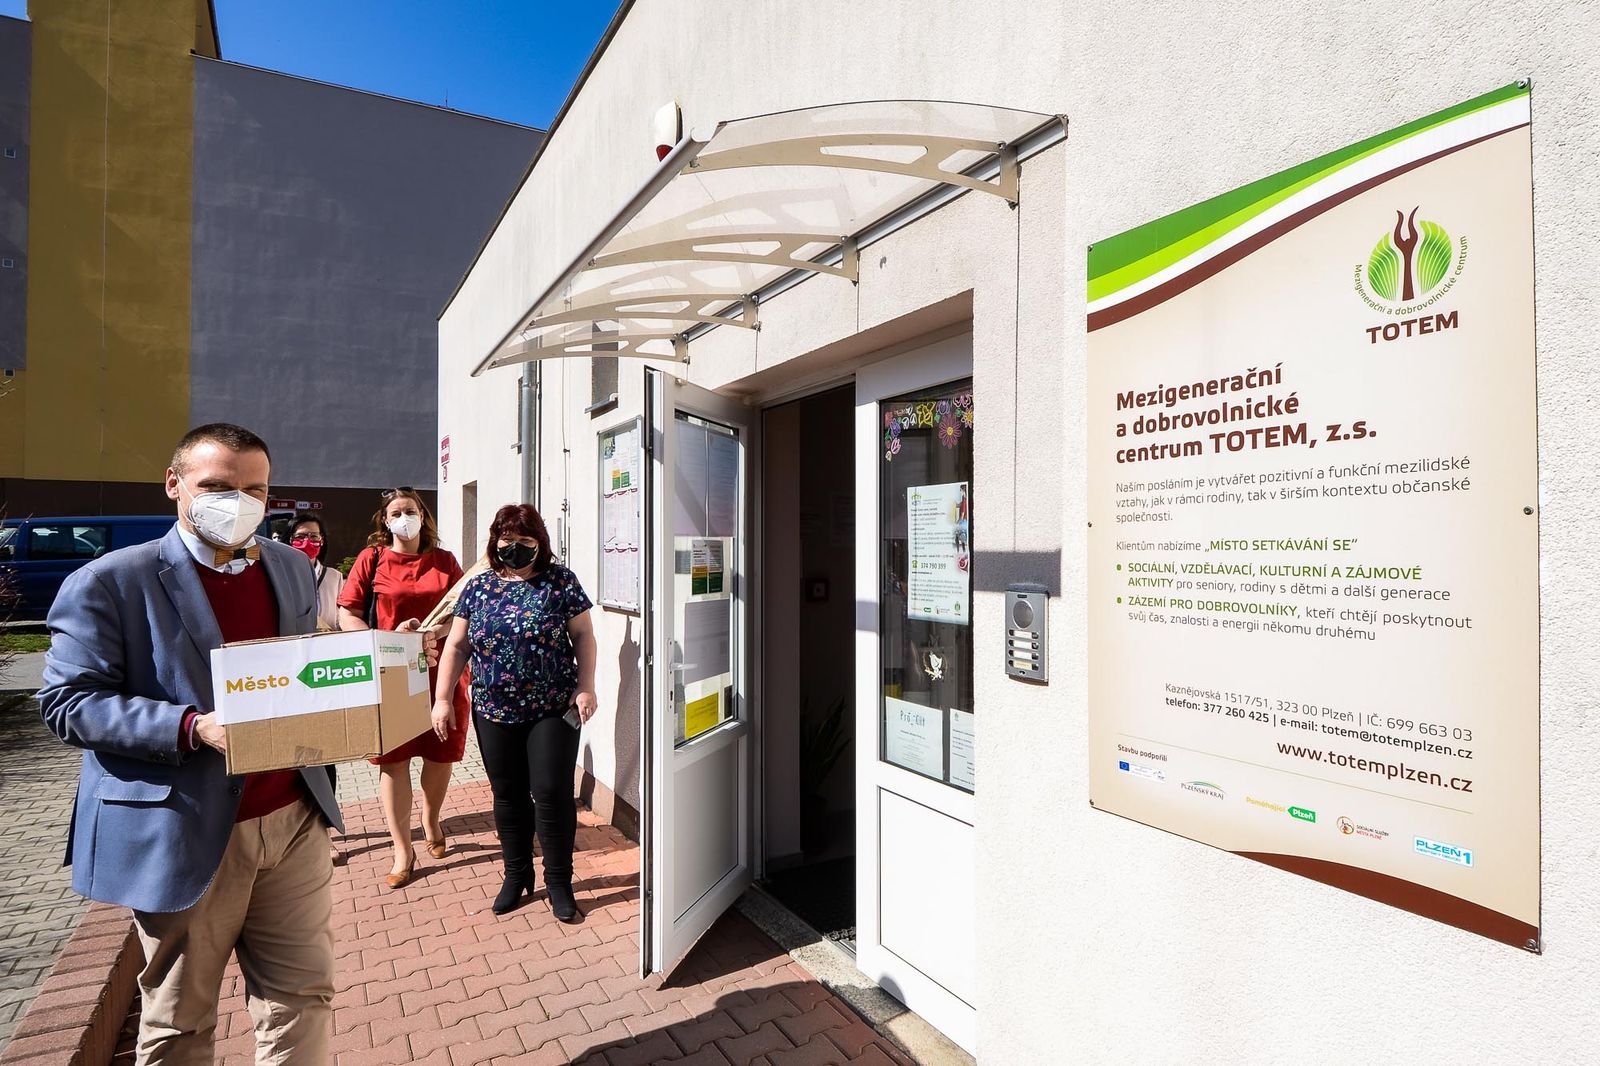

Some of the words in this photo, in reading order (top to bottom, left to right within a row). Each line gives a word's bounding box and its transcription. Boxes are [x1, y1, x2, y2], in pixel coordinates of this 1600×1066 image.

[1355, 264, 1386, 313] Mezigenerační
[1455, 235, 1468, 275] centrum
[1366, 310, 1459, 344] TOTEM
[1116, 362, 1284, 411] Mezigenerační
[1116, 422, 1127, 437] a
[1133, 391, 1300, 435] dobrovolnické
[1116, 439, 1203, 464] centrum
[1209, 422, 1318, 454] TOTEM,
[1326, 421, 1377, 442] z.s.
[1116, 482, 1145, 493] Naším
[1148, 478, 1193, 492] posláním
[1196, 476, 1205, 490] je
[1208, 473, 1256, 488] vytvářet
[1259, 467, 1313, 484] pozitivní
[1317, 469, 1325, 479] a
[1329, 463, 1381, 478] funkční
[1384, 456, 1471, 474] mezilidské
[1116, 496, 1149, 509] vztahy,
[1150, 494, 1165, 508] jak
[1167, 497, 1173, 505] v
[1175, 492, 1204, 504] rámci
[1207, 491, 1245, 504] rodiny,
[1248, 489, 1267, 501] tak
[1270, 491, 1276, 500] v
[1280, 486, 1319, 500] širším
[1322, 483, 1388, 497] kontextu
[1392, 477, 1471, 494] občanské
[1116, 511, 1173, 524] společnosti.
[1116, 541, 1155, 551] Klientům
[1252, 537, 1328, 551] SETKÁVÁNÍ
[1128, 561, 1178, 575] SOCIÁLNÍ,
[1181, 562, 1256, 577] VZDĚLÁVACÍ,
[1260, 563, 1327, 578] KULTURNÍ
[1331, 566, 1342, 578] A
[1346, 565, 1422, 580] ZÁJMOVÉ
[1128, 577, 1174, 588] AKTIVITY
[1176, 579, 1193, 590] pro
[1196, 580, 1237, 593] seniory,
[1240, 581, 1276, 595] rodiny
[1280, 585, 1286, 594] s
[1290, 583, 1327, 595] dětmi
[1331, 586, 1339, 596] a
[1344, 585, 1376, 597] další
[1380, 588, 1451, 601] generace
[1128, 595, 1166, 608] ZÁZEMÍ
[1170, 598, 1193, 609] PRO
[1197, 600, 1301, 619] DOBROVOLNÍKY,
[1306, 606, 1335, 619] kteří
[1340, 609, 1377, 624] chtějí
[1383, 612, 1472, 629] poskytnout
[1128, 611, 1146, 623] svůj
[1149, 611, 1167, 624] čas,
[1170, 614, 1209, 627] znalosti
[1212, 618, 1219, 627] a
[1222, 619, 1259, 633] energii
[1263, 622, 1311, 635] někomu
[1316, 624, 1376, 640] druhému
[226, 675, 290, 694] Město
[313, 661, 366, 682] Plzeň
[1165, 683, 1221, 701] Kaznějovská
[1224, 692, 1273, 711] 1517/51,
[1276, 700, 1299, 713] 323
[1302, 704, 1318, 716] 00
[1322, 707, 1354, 722] Plzeň
[1367, 712, 1382, 727] IČ:
[1387, 717, 1414, 732] 699
[1419, 722, 1448, 738] 663
[1452, 727, 1473, 742] 03
[1165, 697, 1201, 711] telefon:
[1203, 702, 1222, 714] 377
[1225, 706, 1246, 718] 260
[1248, 711, 1270, 723] 425
[1280, 718, 1318, 732] e-mail:
[1321, 724, 1473, 759] totem@totemplzen.cz
[1117, 744, 1139, 756] Stavbu
[1140, 751, 1168, 762] podpořili
[1276, 742, 1473, 793] www.totemplzen.cz
[1210, 791, 1224, 801] KRAJ
[1293, 808, 1314, 820] Plzeň
[1463, 852, 1471, 864] 1
